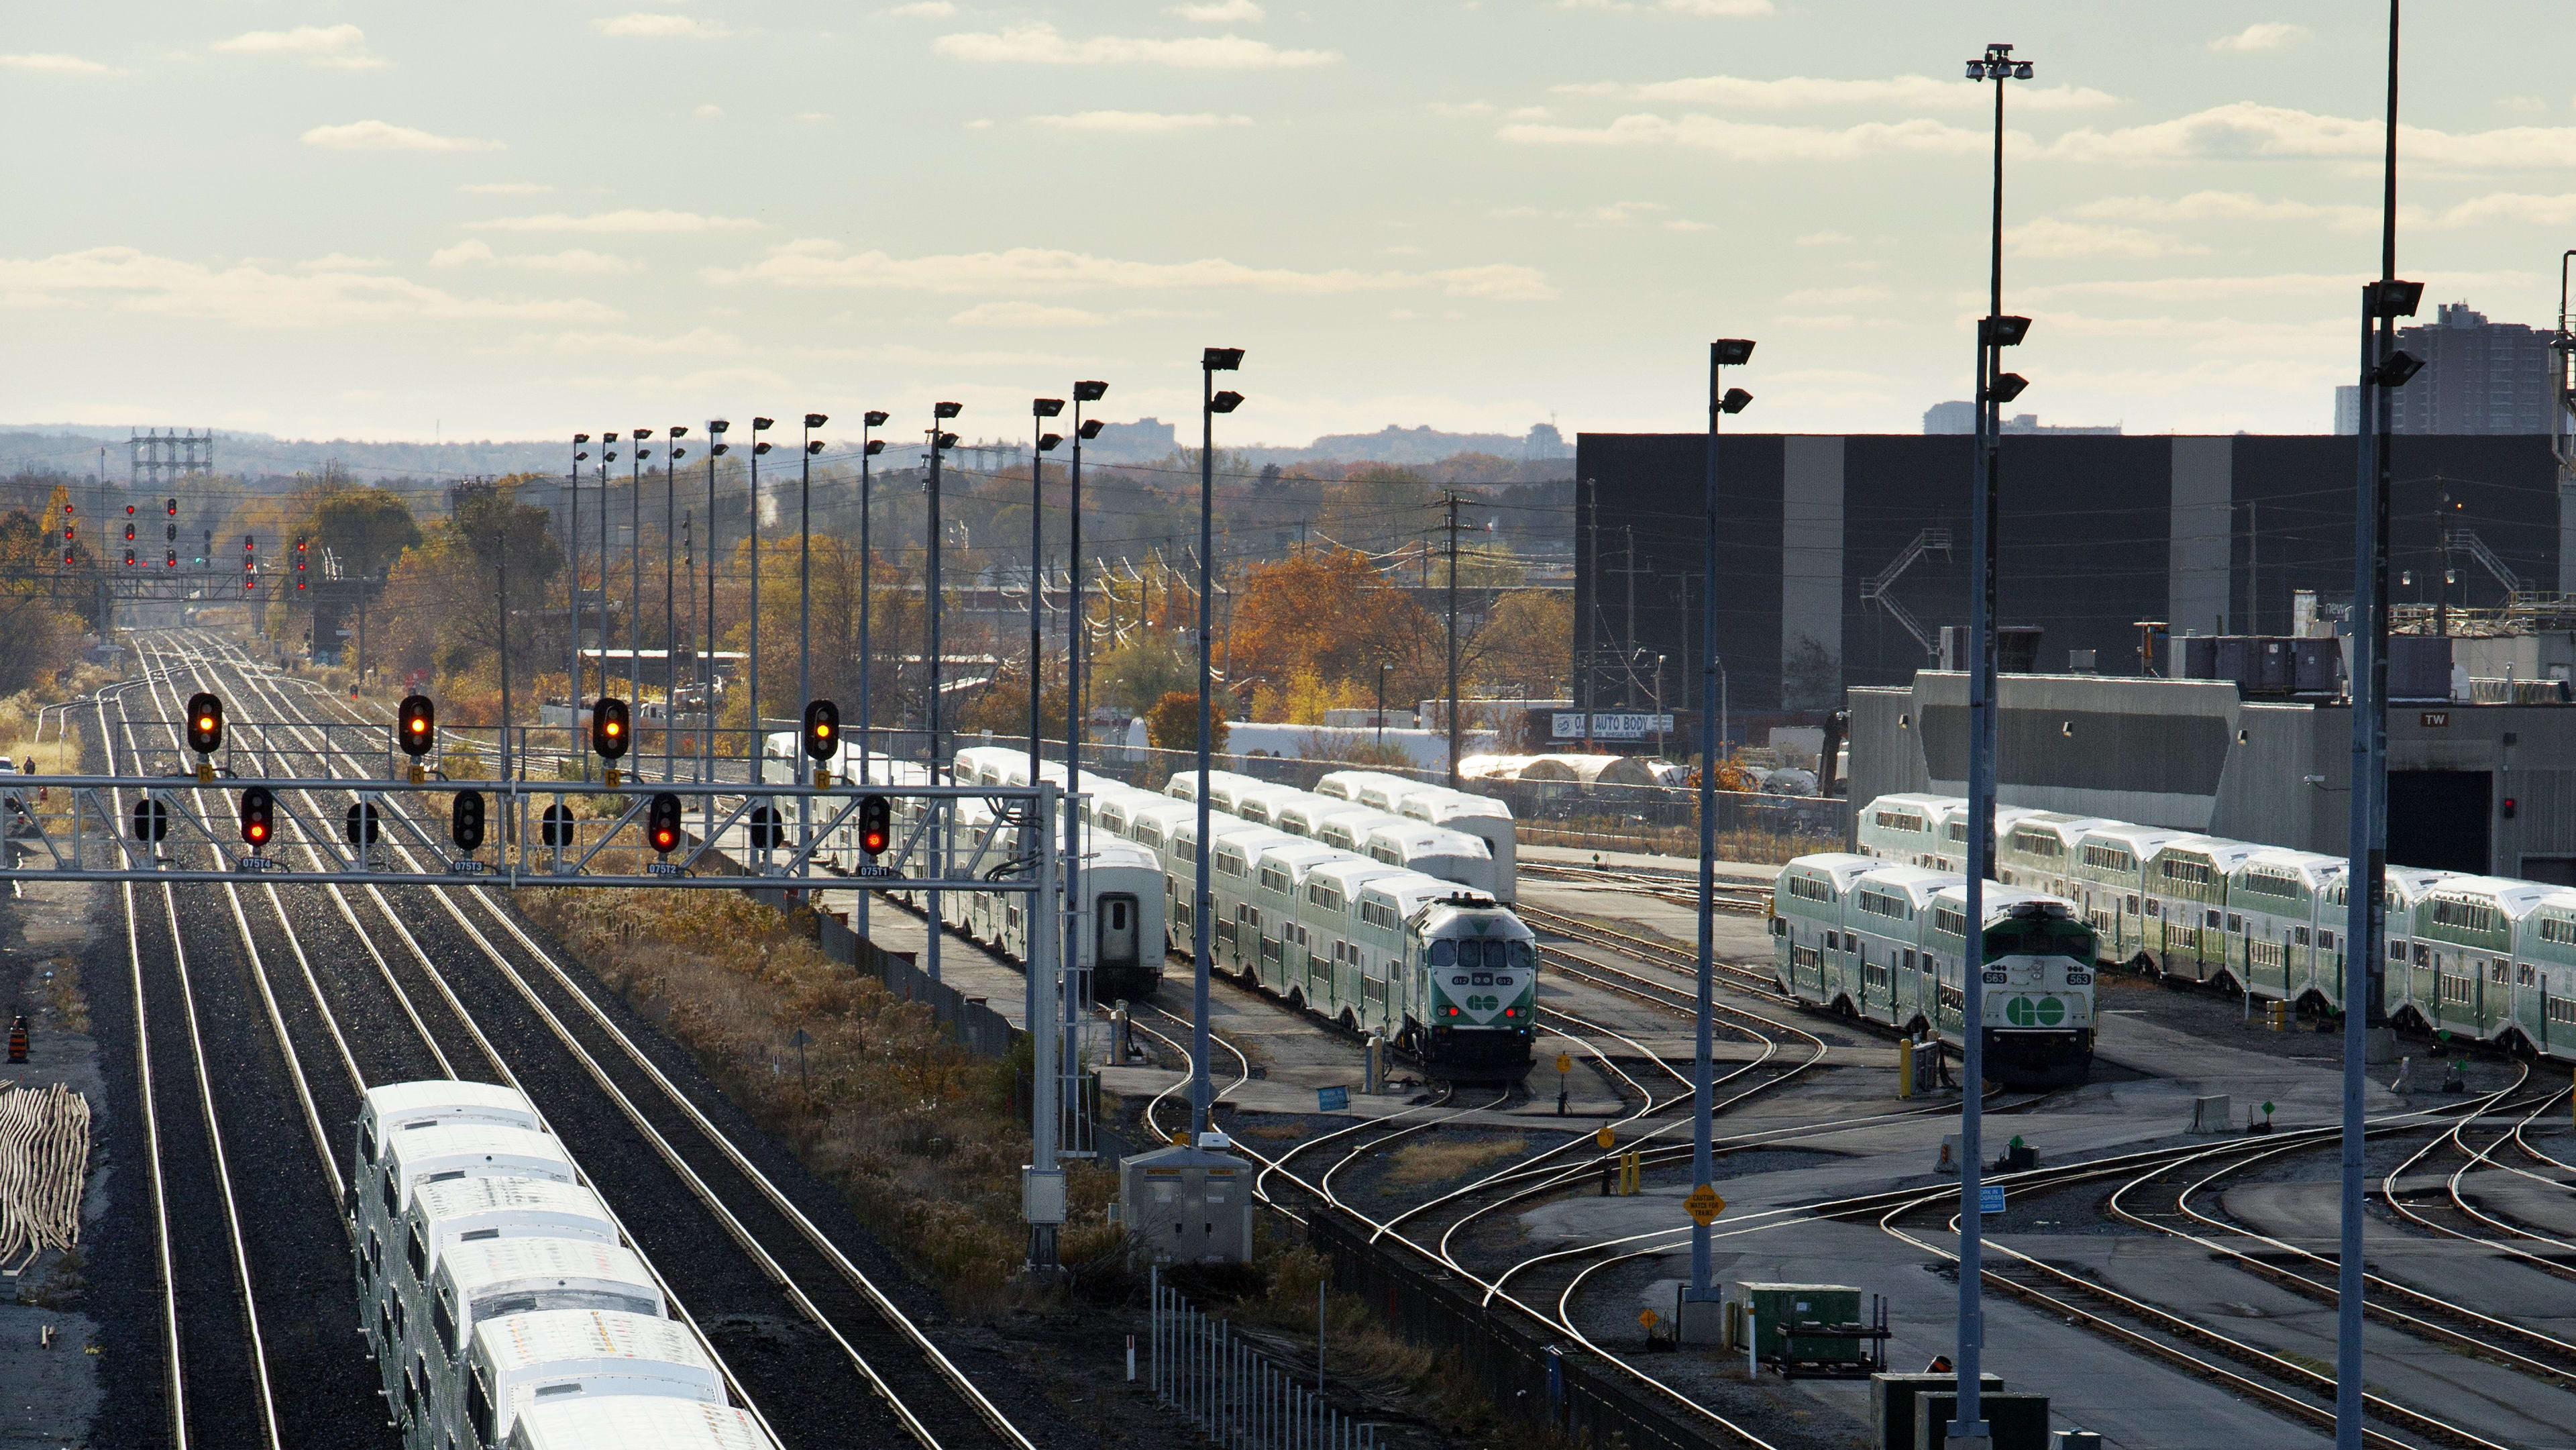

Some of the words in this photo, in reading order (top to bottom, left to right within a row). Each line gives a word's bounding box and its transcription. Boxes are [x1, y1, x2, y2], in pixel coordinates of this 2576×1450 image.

[1595, 715, 1620, 730] AUTO
[1623, 716, 1648, 730] BODY
[2425, 715, 2445, 725] TW
[201, 766, 210, 780] R
[412, 768, 421, 781] R
[608, 772, 617, 785] R
[818, 773, 827, 787] R
[243, 858, 271, 868] 075T4
[455, 862, 482, 871] 075T3
[649, 864, 676, 873] 075T2
[861, 867, 888, 876] 075T1
[1986, 974, 2004, 983] 563
[2070, 975, 2088, 984] 563
[1466, 995, 1499, 1011] GO
[2006, 996, 2065, 1026] GO
